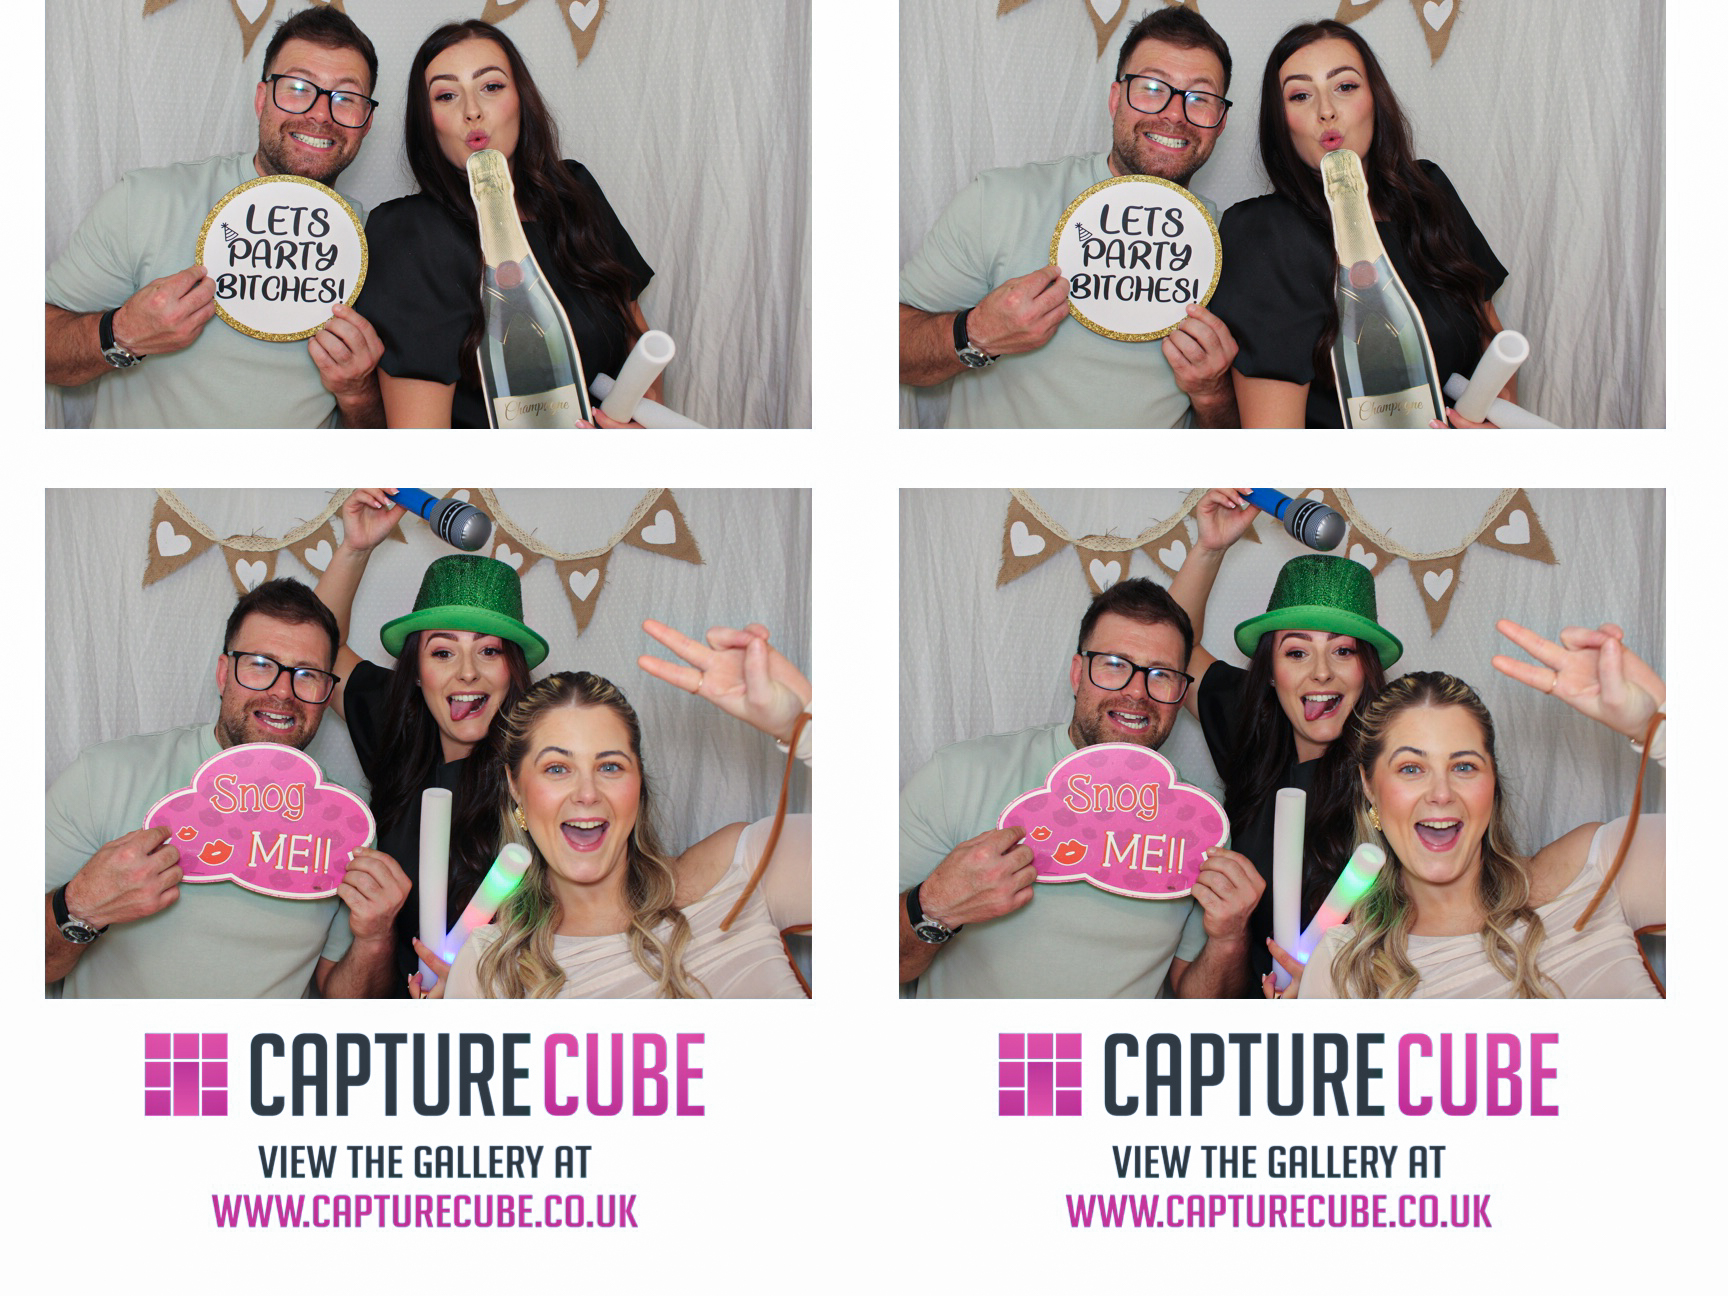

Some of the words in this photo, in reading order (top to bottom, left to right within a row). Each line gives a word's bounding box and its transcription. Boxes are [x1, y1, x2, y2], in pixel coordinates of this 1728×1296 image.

[246, 204, 330, 237] LETS
[1100, 204, 1184, 237] LETS
[228, 238, 338, 271] PARTY
[1082, 238, 1192, 271] PARTY
[216, 273, 345, 304] BITCHES!
[1070, 273, 1199, 304] BITCHES!
[209, 774, 306, 821] Snog
[1063, 774, 1160, 821] Snog
[248, 831, 332, 875] ME!!
[1102, 831, 1186, 875] ME!!
